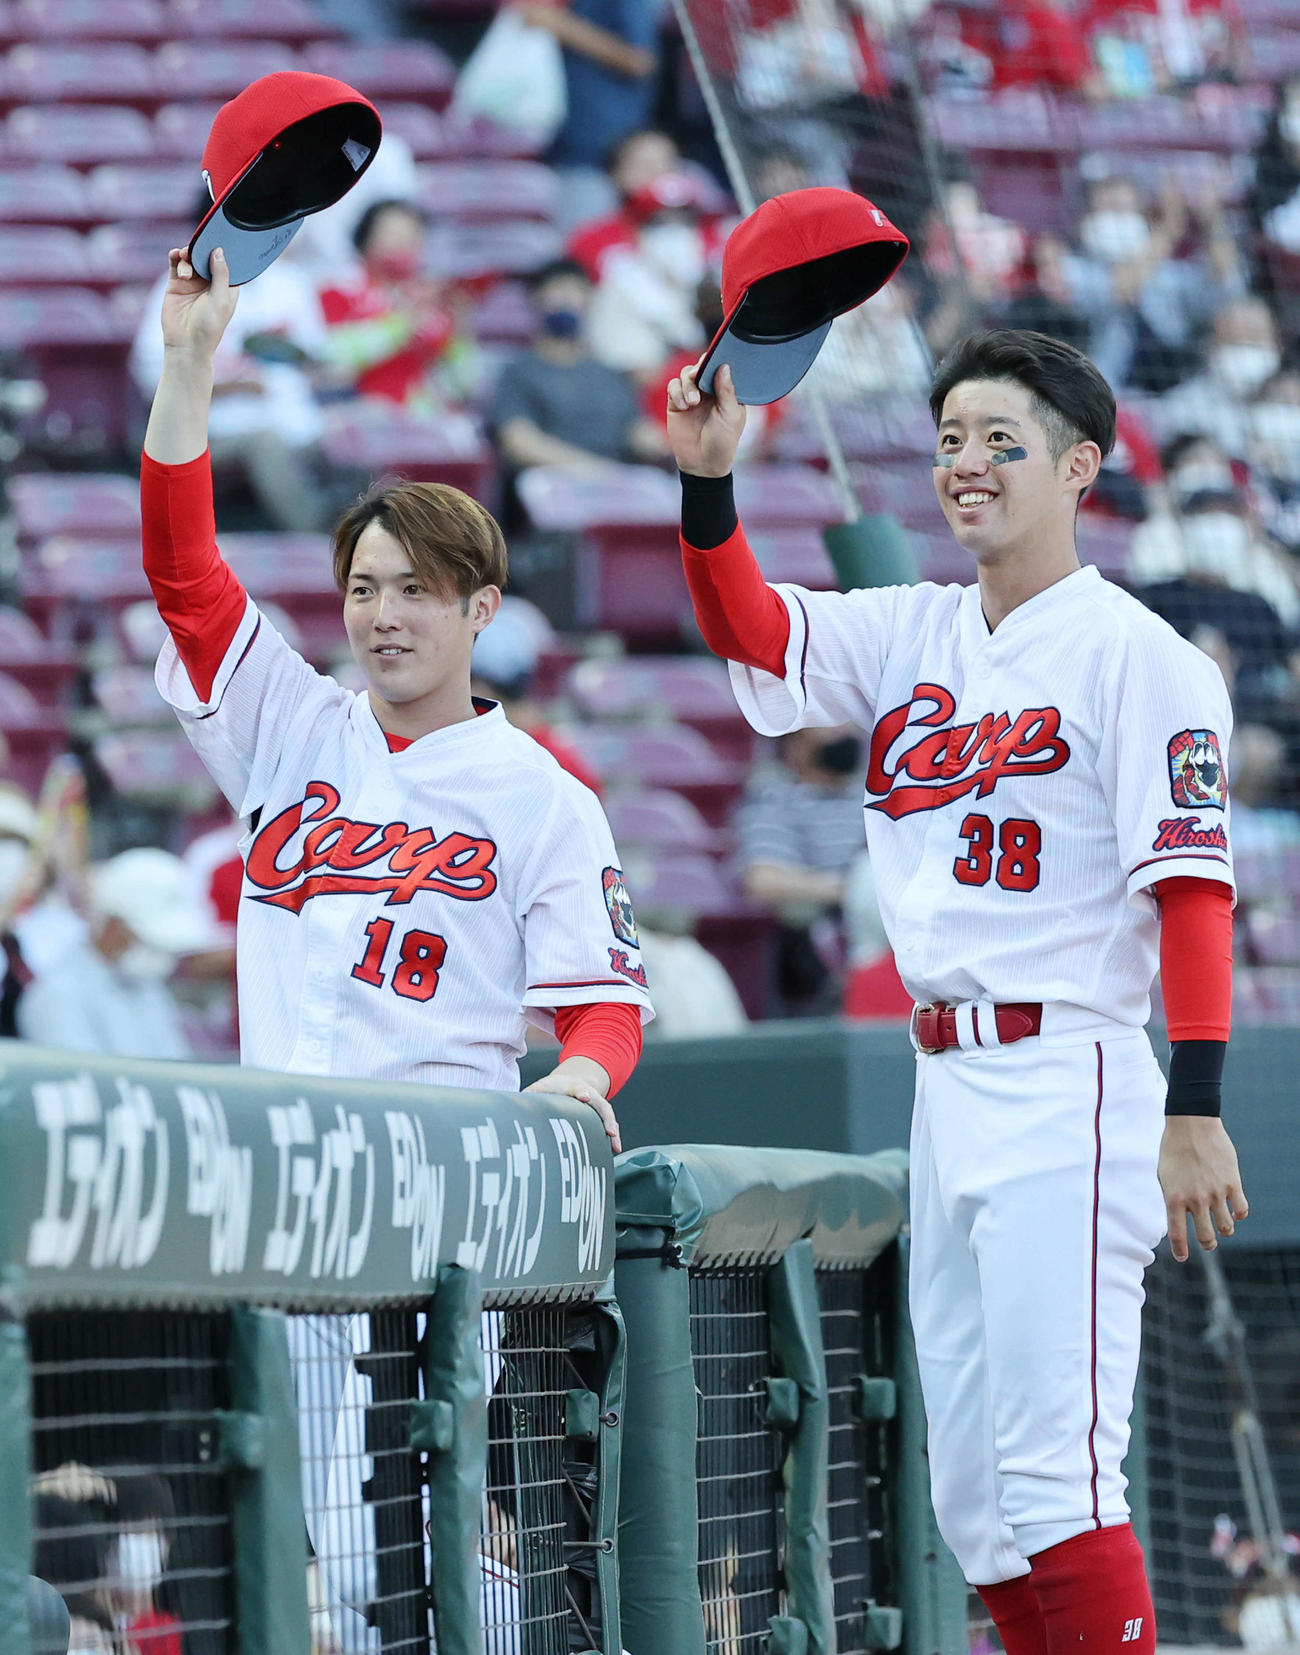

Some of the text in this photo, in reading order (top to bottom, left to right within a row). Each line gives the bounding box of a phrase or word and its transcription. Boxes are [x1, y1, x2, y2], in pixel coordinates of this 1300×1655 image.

[864, 683, 1071, 821] Carp
[244, 780, 497, 916] Carp
[953, 812, 1041, 892] 38
[351, 916, 448, 1003] 18
[27, 1073, 170, 1270] エディオン
[263, 1097, 375, 1280] エディオン
[384, 1111, 446, 1282] EDION
[456, 1117, 547, 1279] エディオン
[549, 1118, 606, 1274] EDION
[1121, 1617, 1143, 1642] 38
